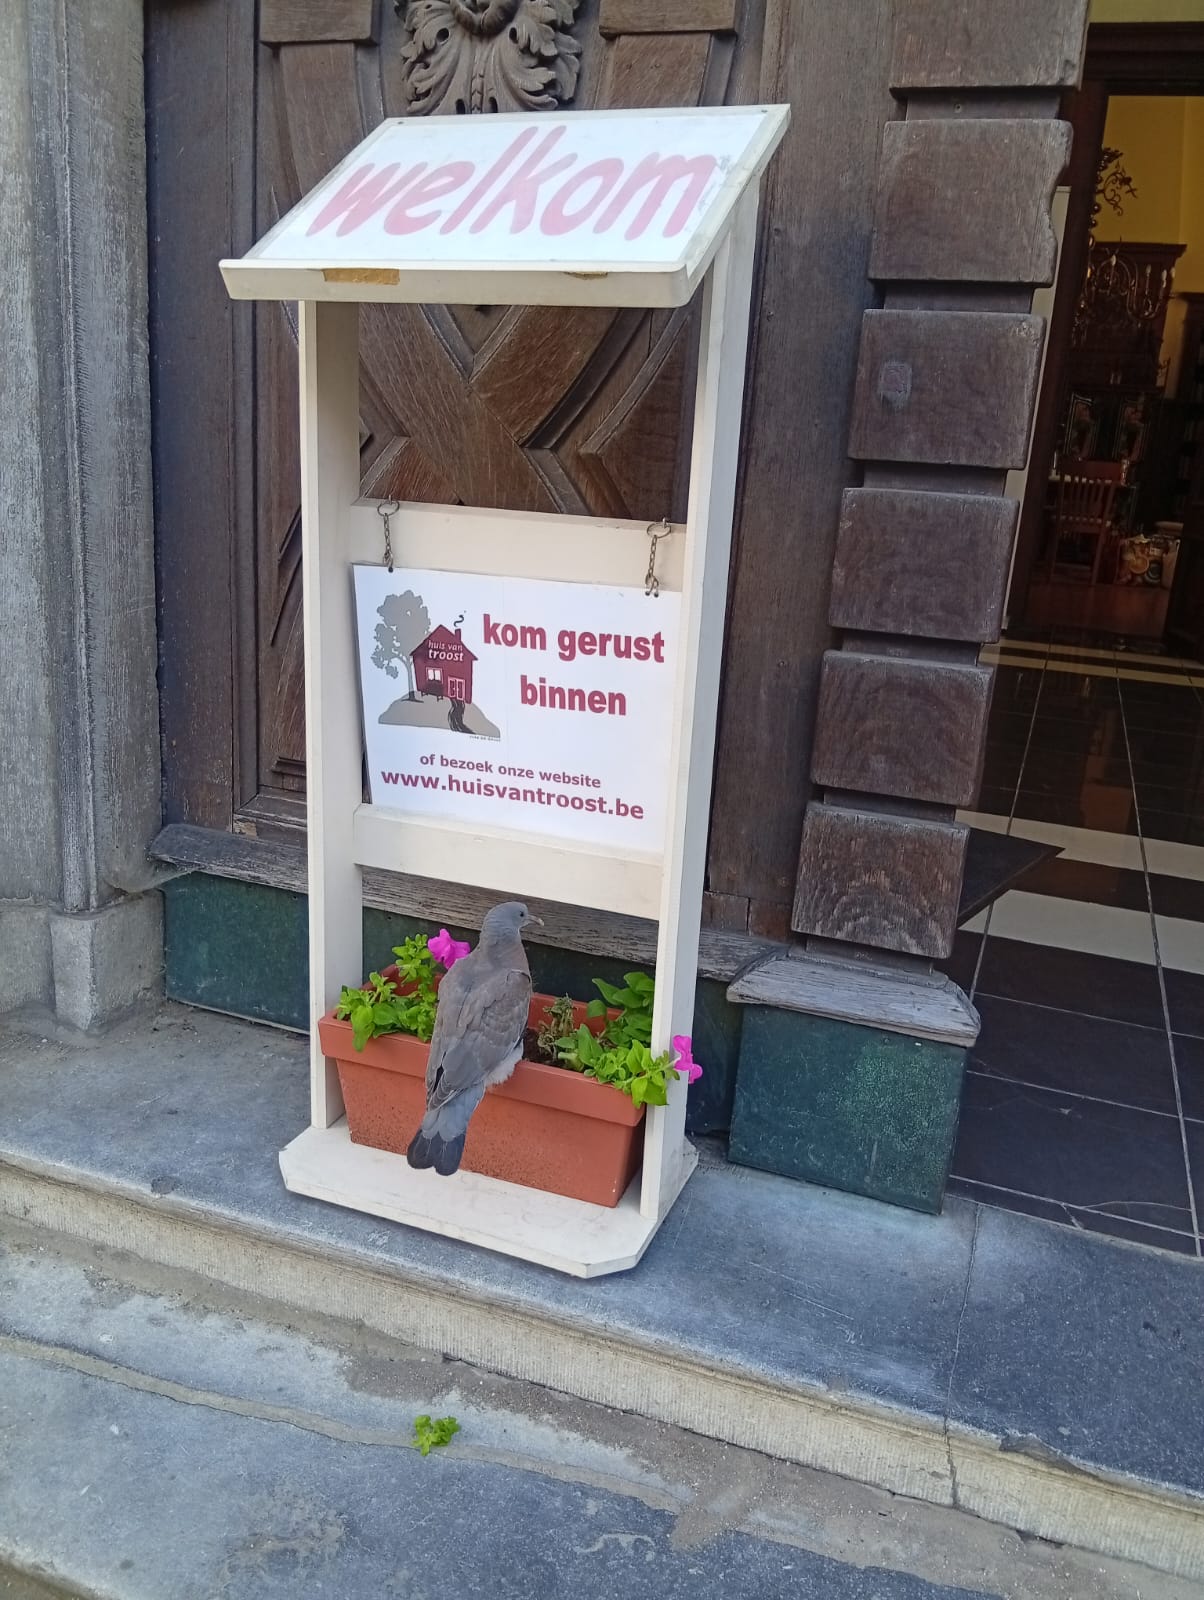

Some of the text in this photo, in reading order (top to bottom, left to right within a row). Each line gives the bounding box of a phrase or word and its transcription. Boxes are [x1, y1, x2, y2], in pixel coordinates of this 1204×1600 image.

[305, 125, 718, 241] welkom
[428, 639, 463, 652] huis van
[428, 649, 464, 662] troost
[482, 613, 665, 664] kom gerust
[520, 674, 627, 716] binnen
[419, 753, 601, 789] of bezoek onze website
[381, 770, 644, 820] www.huisvantroost.be
